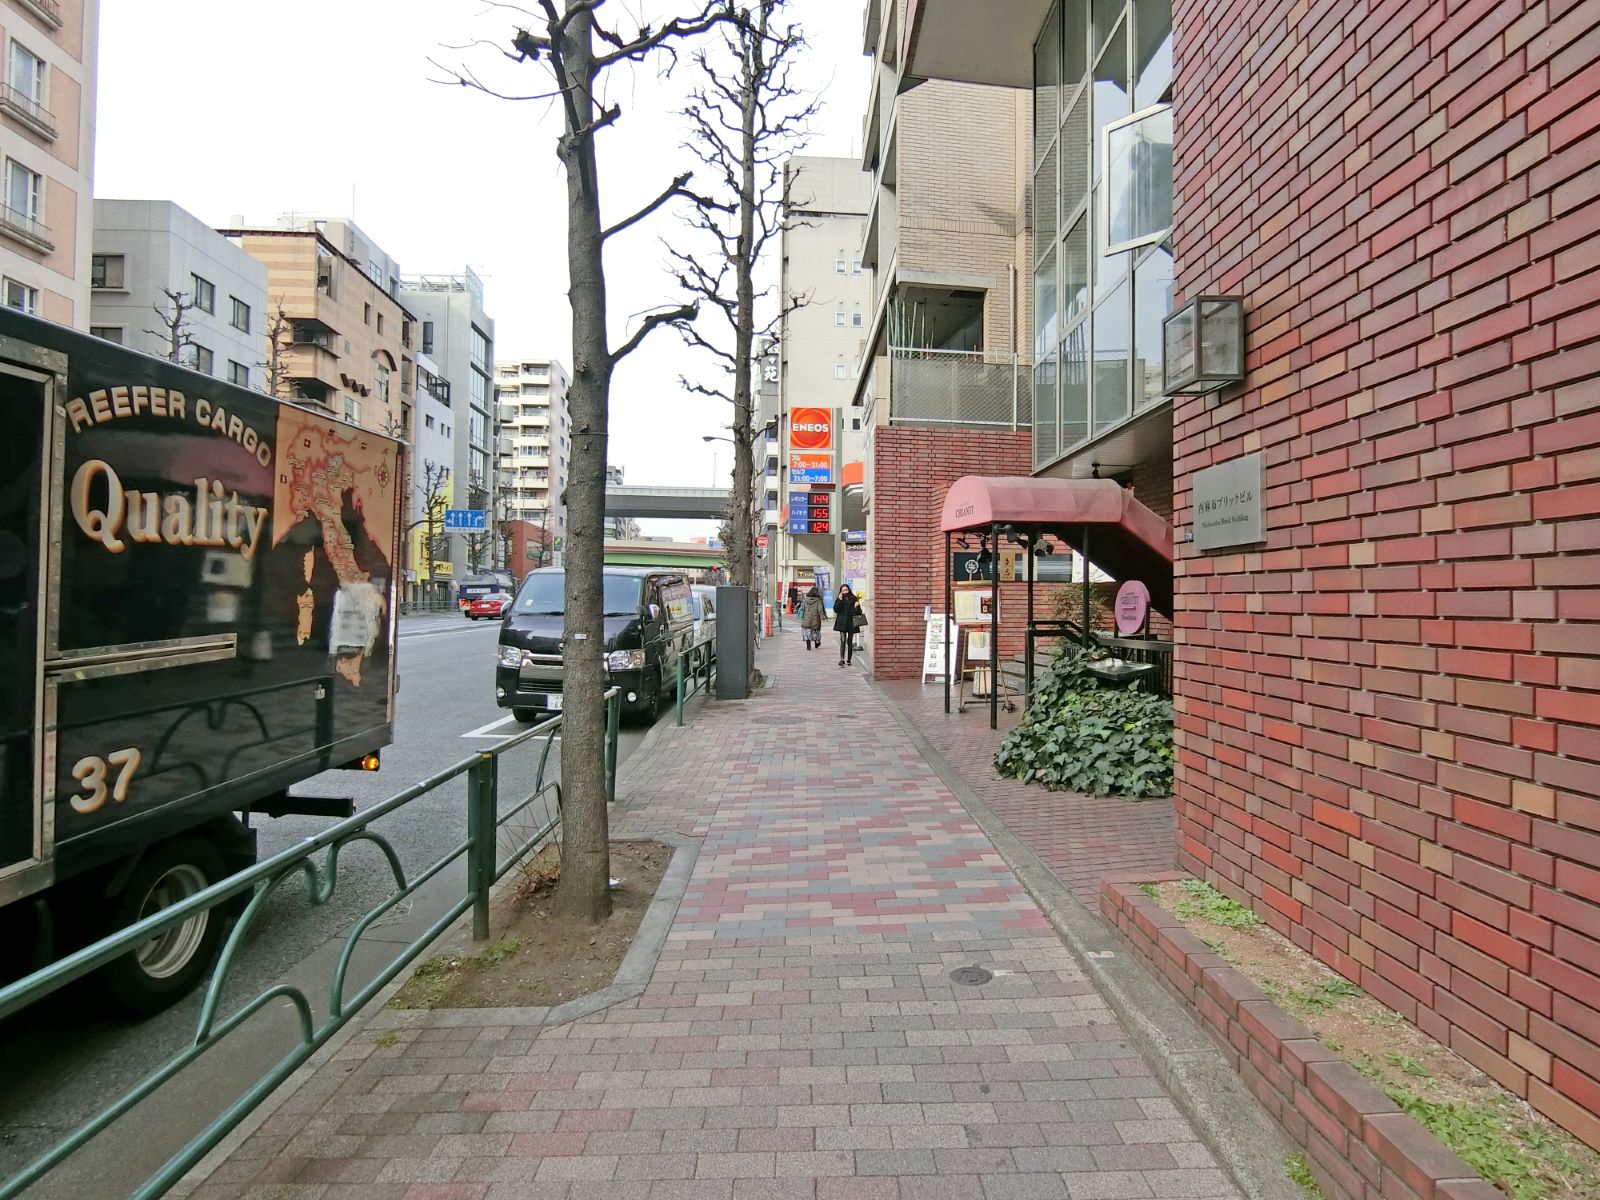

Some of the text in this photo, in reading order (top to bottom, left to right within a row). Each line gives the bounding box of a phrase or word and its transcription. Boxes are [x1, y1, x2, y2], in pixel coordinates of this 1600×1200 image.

[65, 385, 272, 468] REEFER CARGO
[792, 423, 829, 433] ENEOS
[813, 495, 829, 505] 144
[70, 459, 268, 560] Quality
[813, 508, 828, 519] 155
[813, 522, 829, 532] 124
[70, 747, 142, 813] 37
